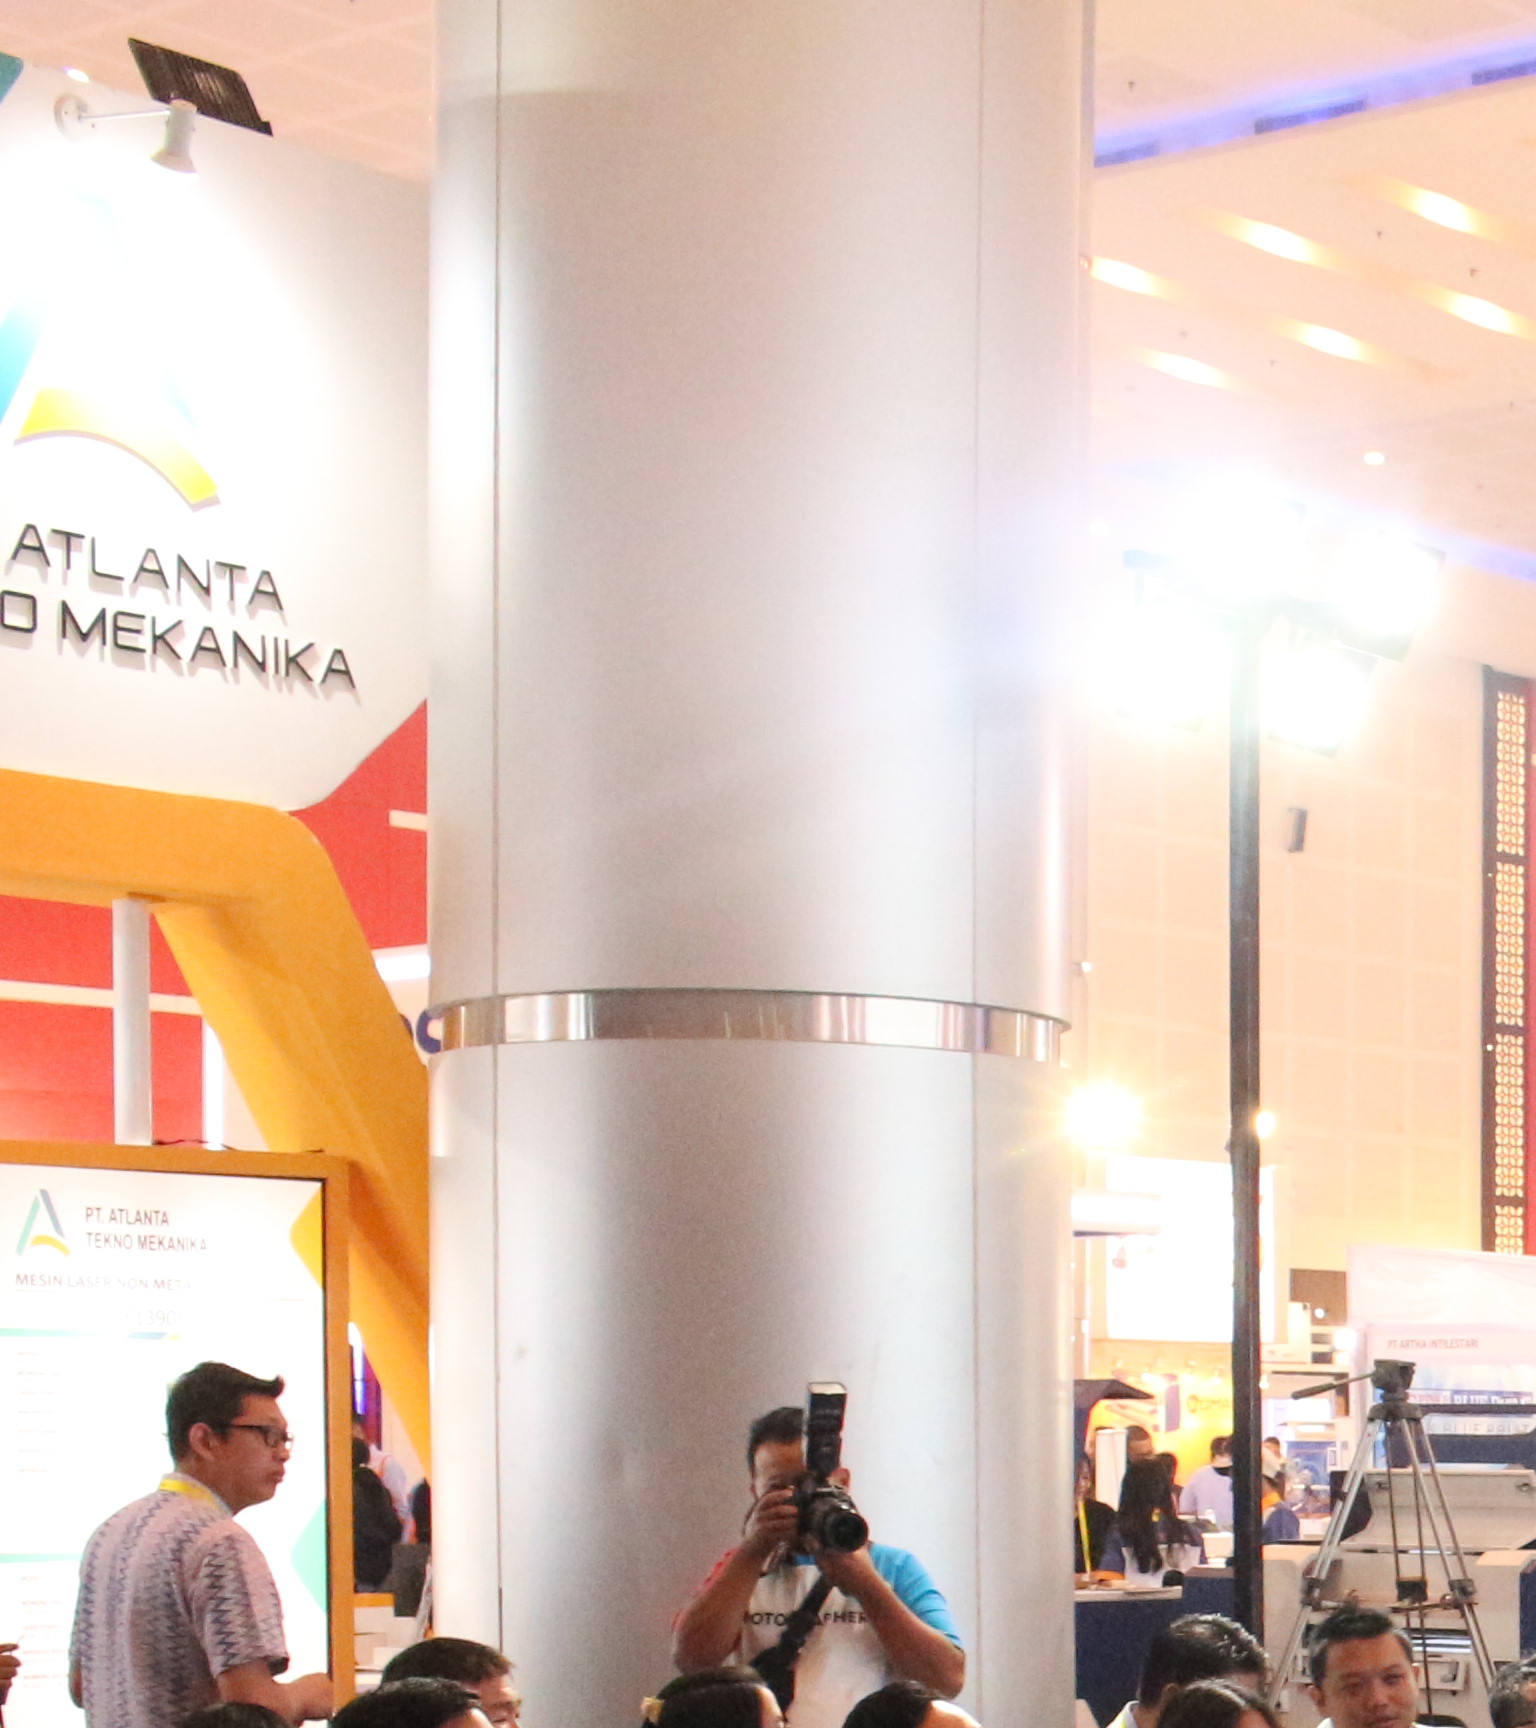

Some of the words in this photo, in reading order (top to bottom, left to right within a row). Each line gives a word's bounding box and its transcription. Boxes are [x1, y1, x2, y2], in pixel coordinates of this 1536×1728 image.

[11, 523, 284, 612] ATLANTA
[60, 599, 357, 690] MEKANIKA
[108, 1208, 170, 1228] ATLANTA
[86, 1232, 134, 1250] TEKNO
[137, 1233, 208, 1252] MEKANIKA
[15, 1273, 63, 1288] MESIN
[152, 1278, 198, 1292] META
